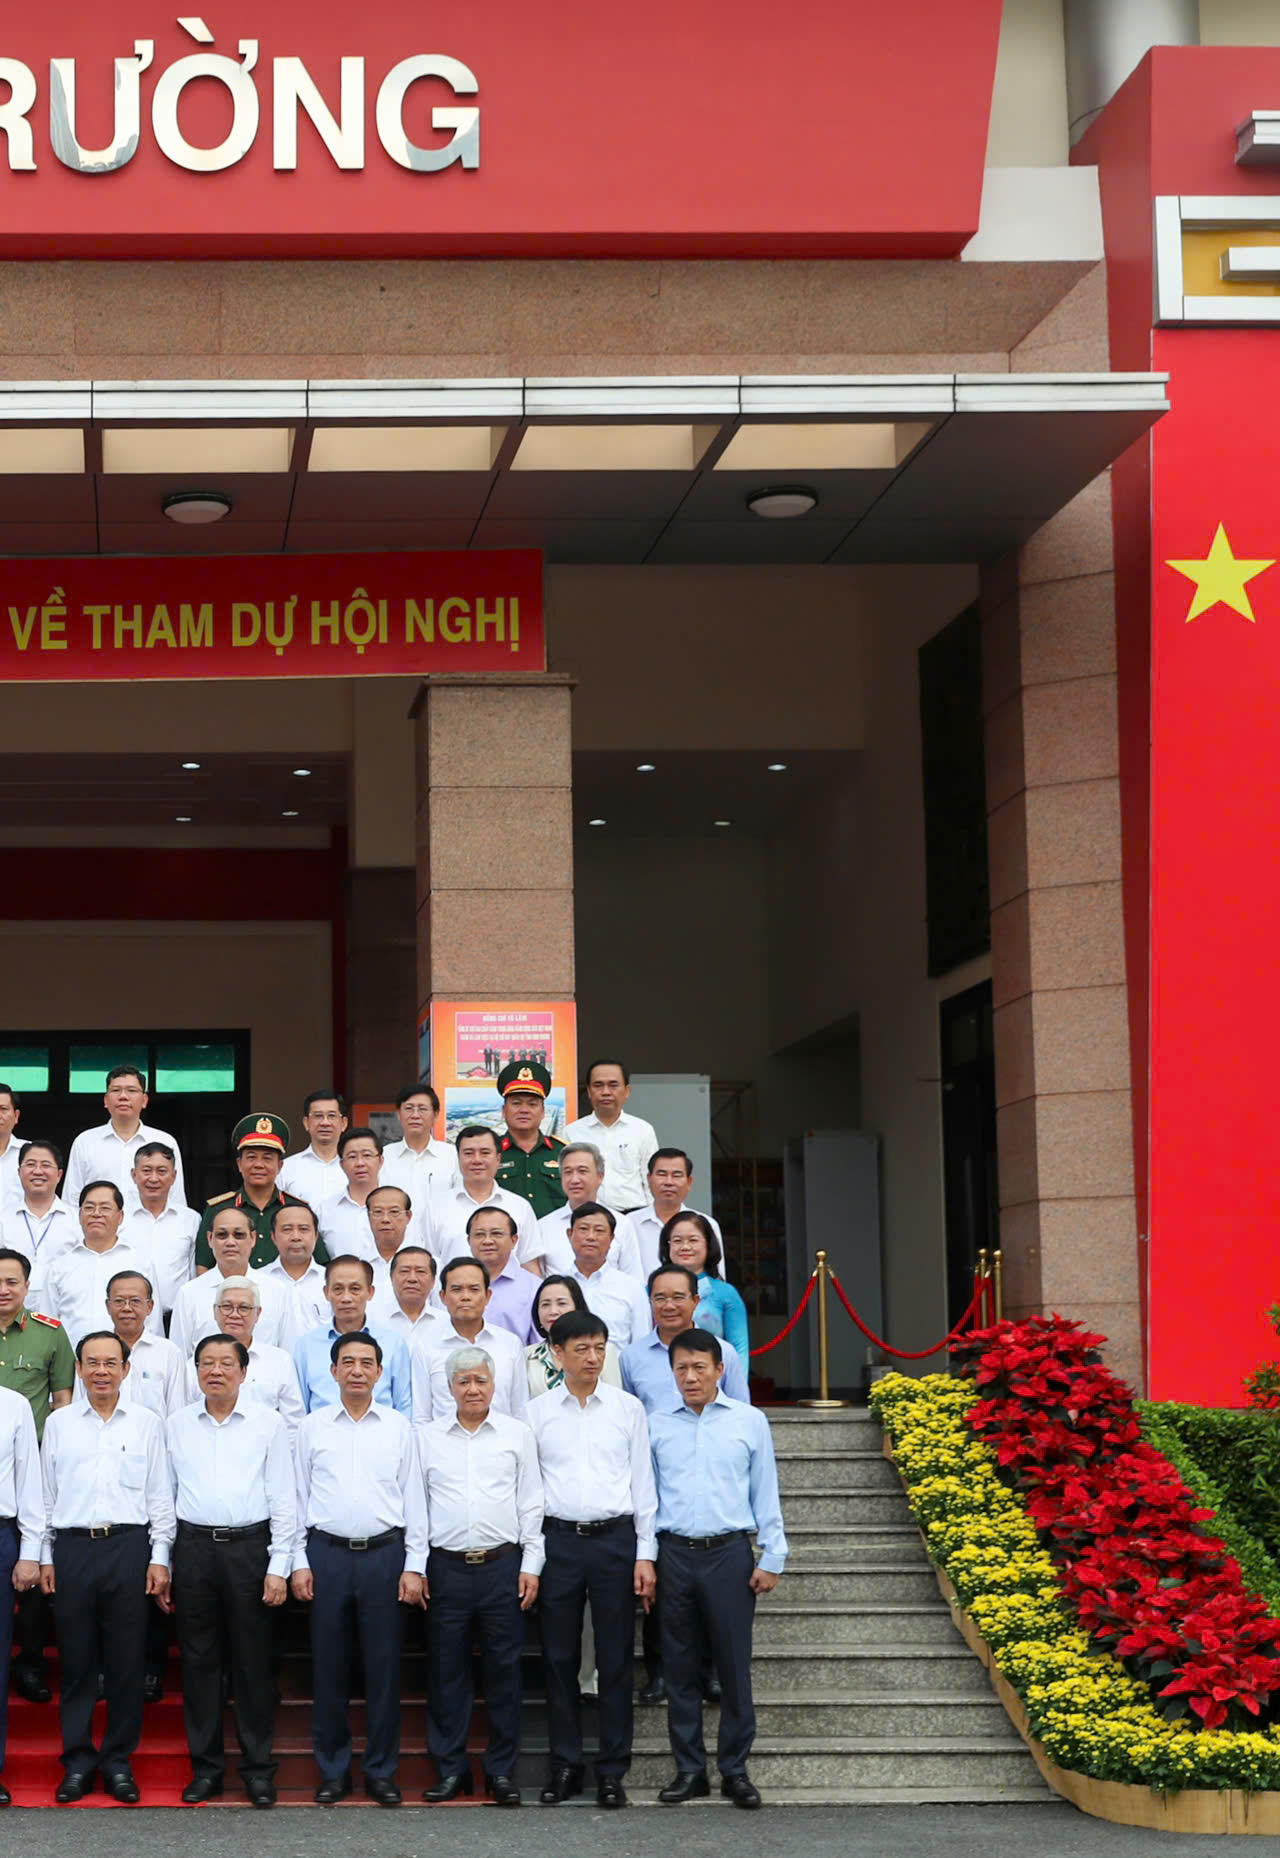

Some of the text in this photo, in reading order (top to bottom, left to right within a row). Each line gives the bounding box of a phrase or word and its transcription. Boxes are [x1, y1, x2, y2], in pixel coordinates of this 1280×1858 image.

[8, 586, 68, 651] VỀ
[83, 603, 214, 649] THAM
[231, 595, 298, 657] DỰ
[311, 587, 388, 655] HỘI
[405, 596, 520, 652] NGHỊ
